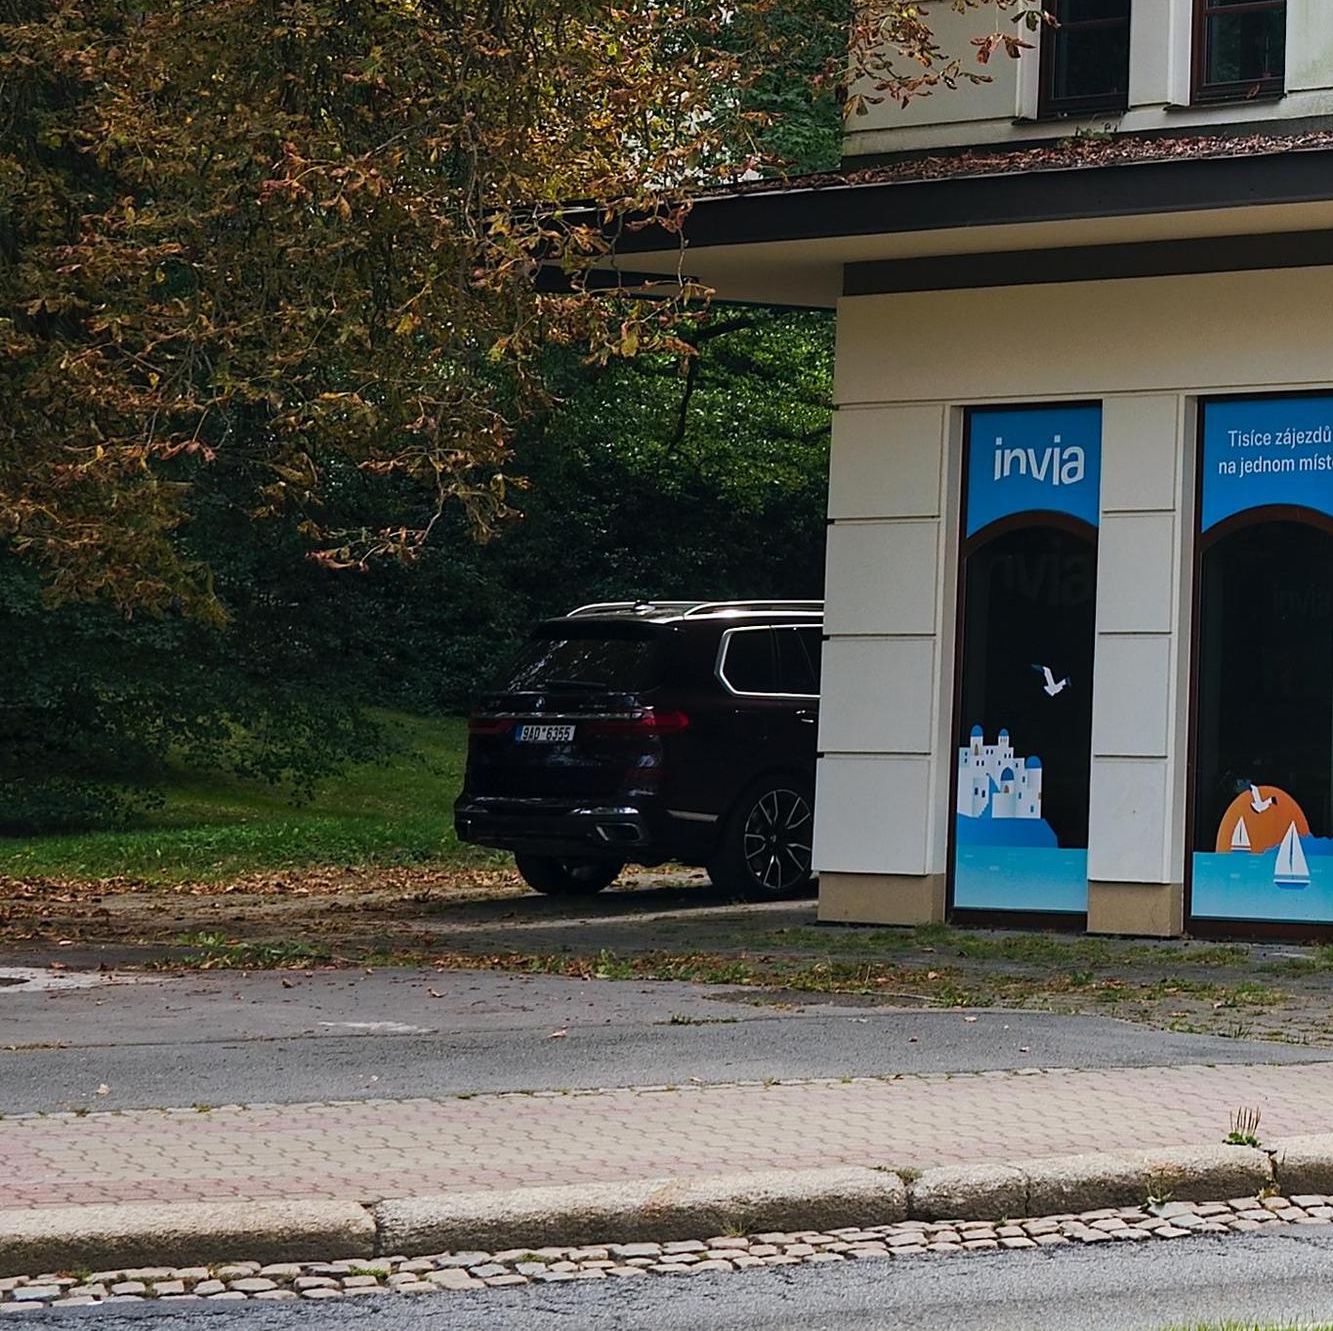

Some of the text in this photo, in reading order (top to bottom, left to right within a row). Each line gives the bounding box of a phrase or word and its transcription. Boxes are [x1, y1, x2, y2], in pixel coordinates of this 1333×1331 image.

[1228, 425, 1332, 449] Tisíce zájezdů
[994, 434, 1084, 486] invia
[1218, 461, 1236, 474] na
[1239, 455, 1295, 478] jednom
